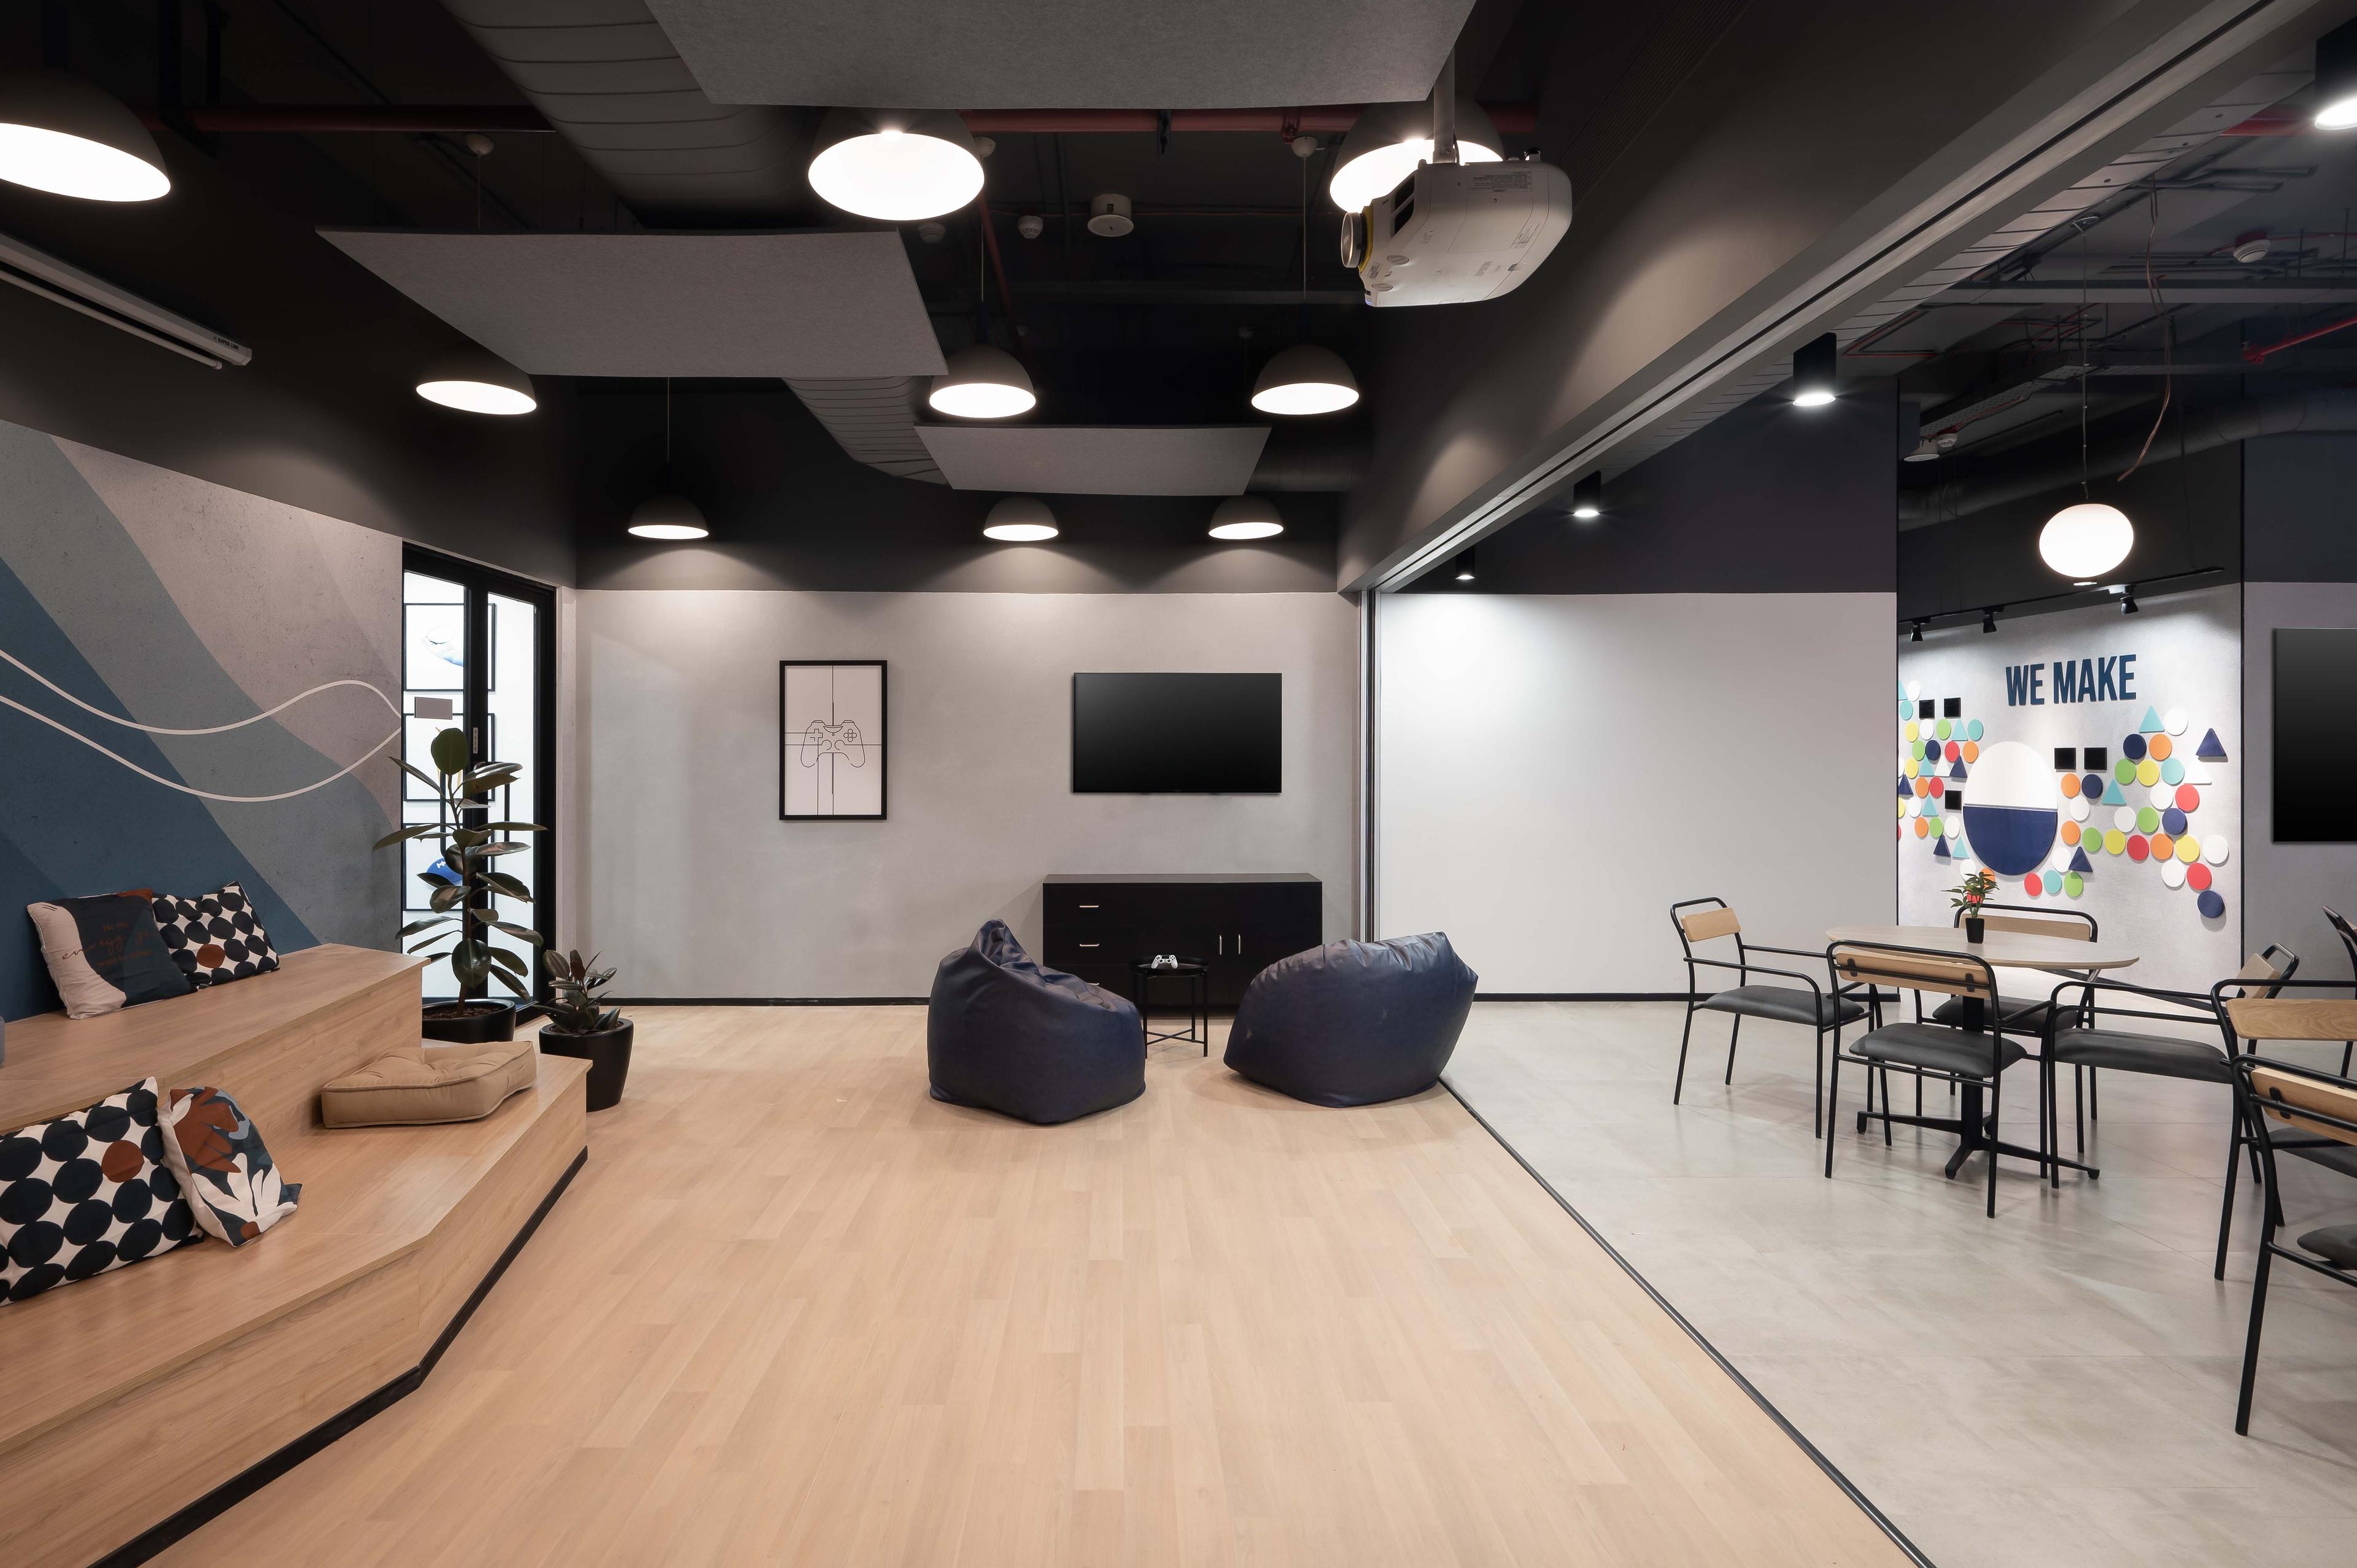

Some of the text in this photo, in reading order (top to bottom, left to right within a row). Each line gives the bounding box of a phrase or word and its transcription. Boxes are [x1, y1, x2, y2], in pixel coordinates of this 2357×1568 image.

[218, 338, 230, 347] SUPER
[2005, 654, 2136, 706] WE MAKE
